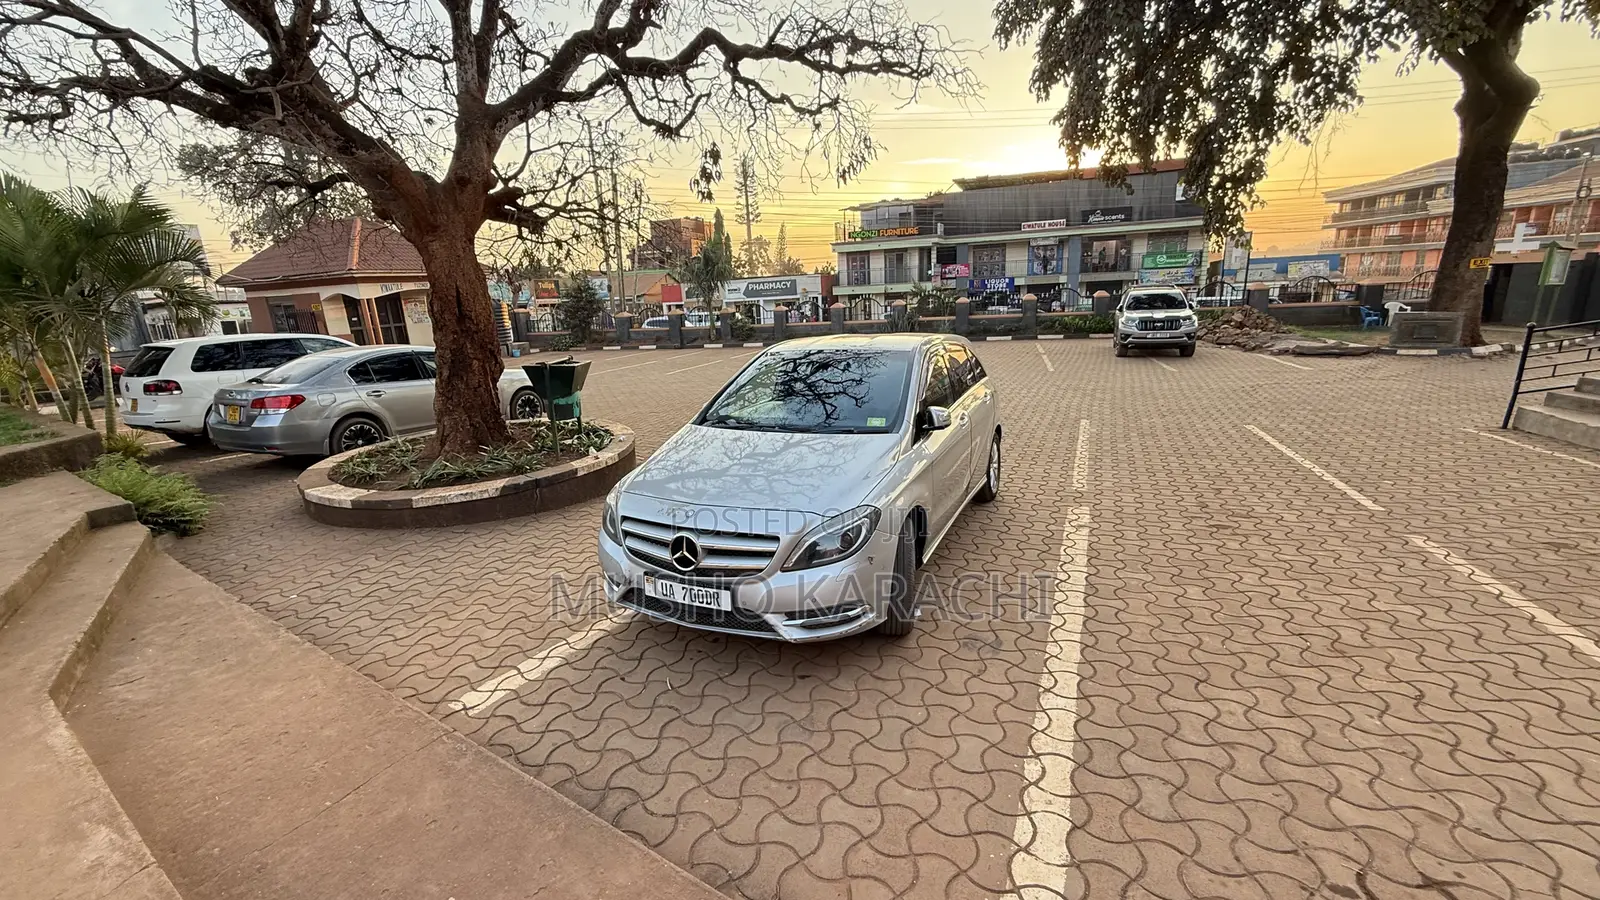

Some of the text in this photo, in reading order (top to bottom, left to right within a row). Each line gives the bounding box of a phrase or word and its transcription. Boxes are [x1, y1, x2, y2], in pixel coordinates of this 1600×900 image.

[1047, 219, 1065, 228] HOUSE
[850, 226, 919, 239] NGONZI FURNITURE
[748, 280, 792, 291] PHARMACY
[984, 277, 1010, 285] LIQUOR
[660, 581, 676, 600] UA
